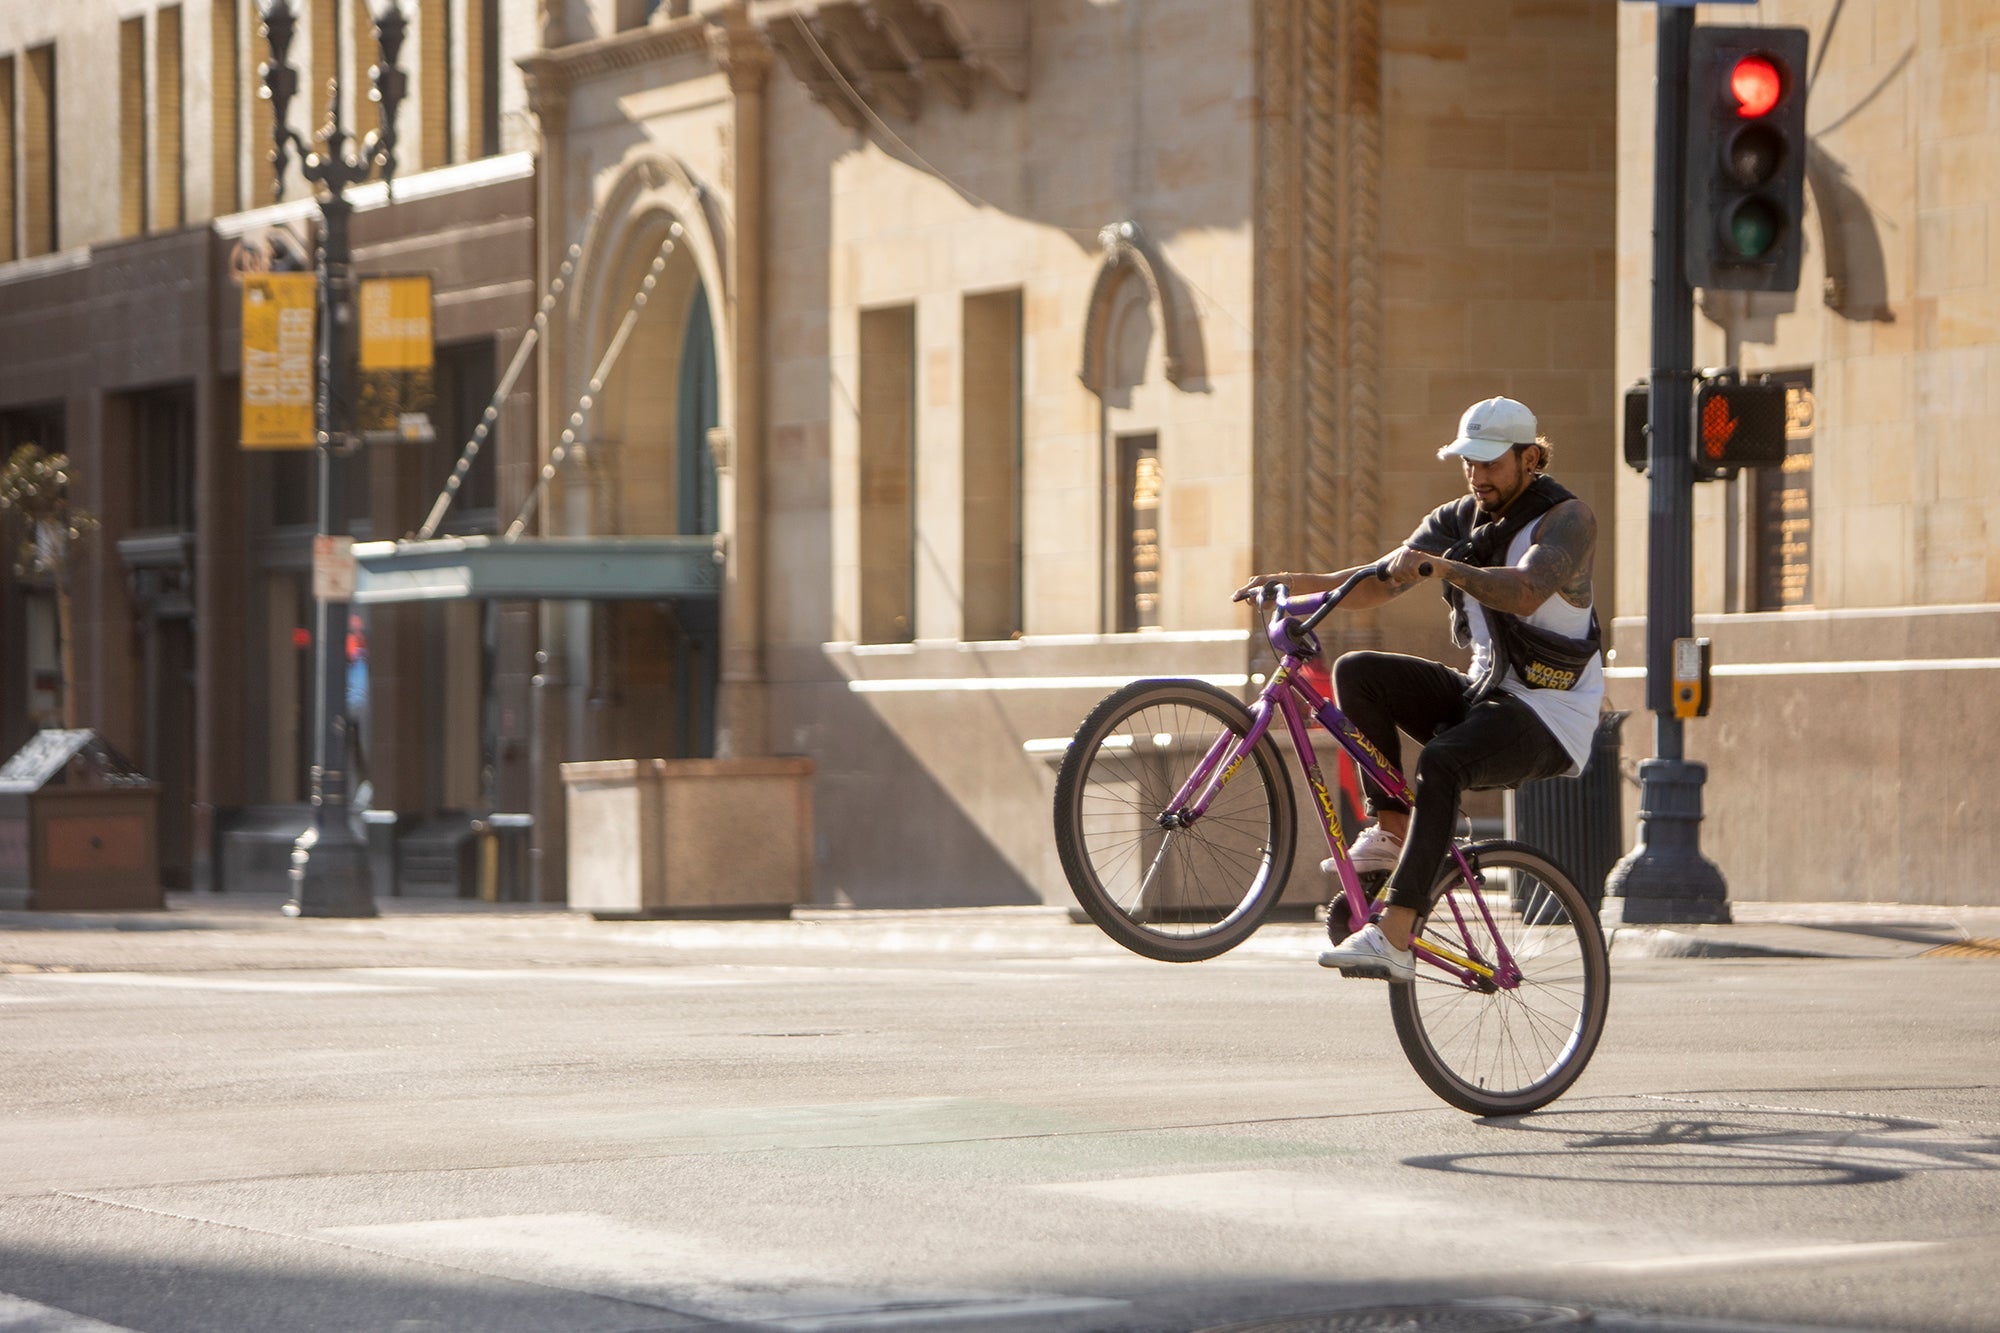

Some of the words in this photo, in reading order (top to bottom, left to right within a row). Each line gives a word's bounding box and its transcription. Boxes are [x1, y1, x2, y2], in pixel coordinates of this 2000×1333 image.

[279, 307, 313, 406] CENTER
[1531, 660, 1575, 680] WOOD
[1526, 672, 1569, 690] WARD
